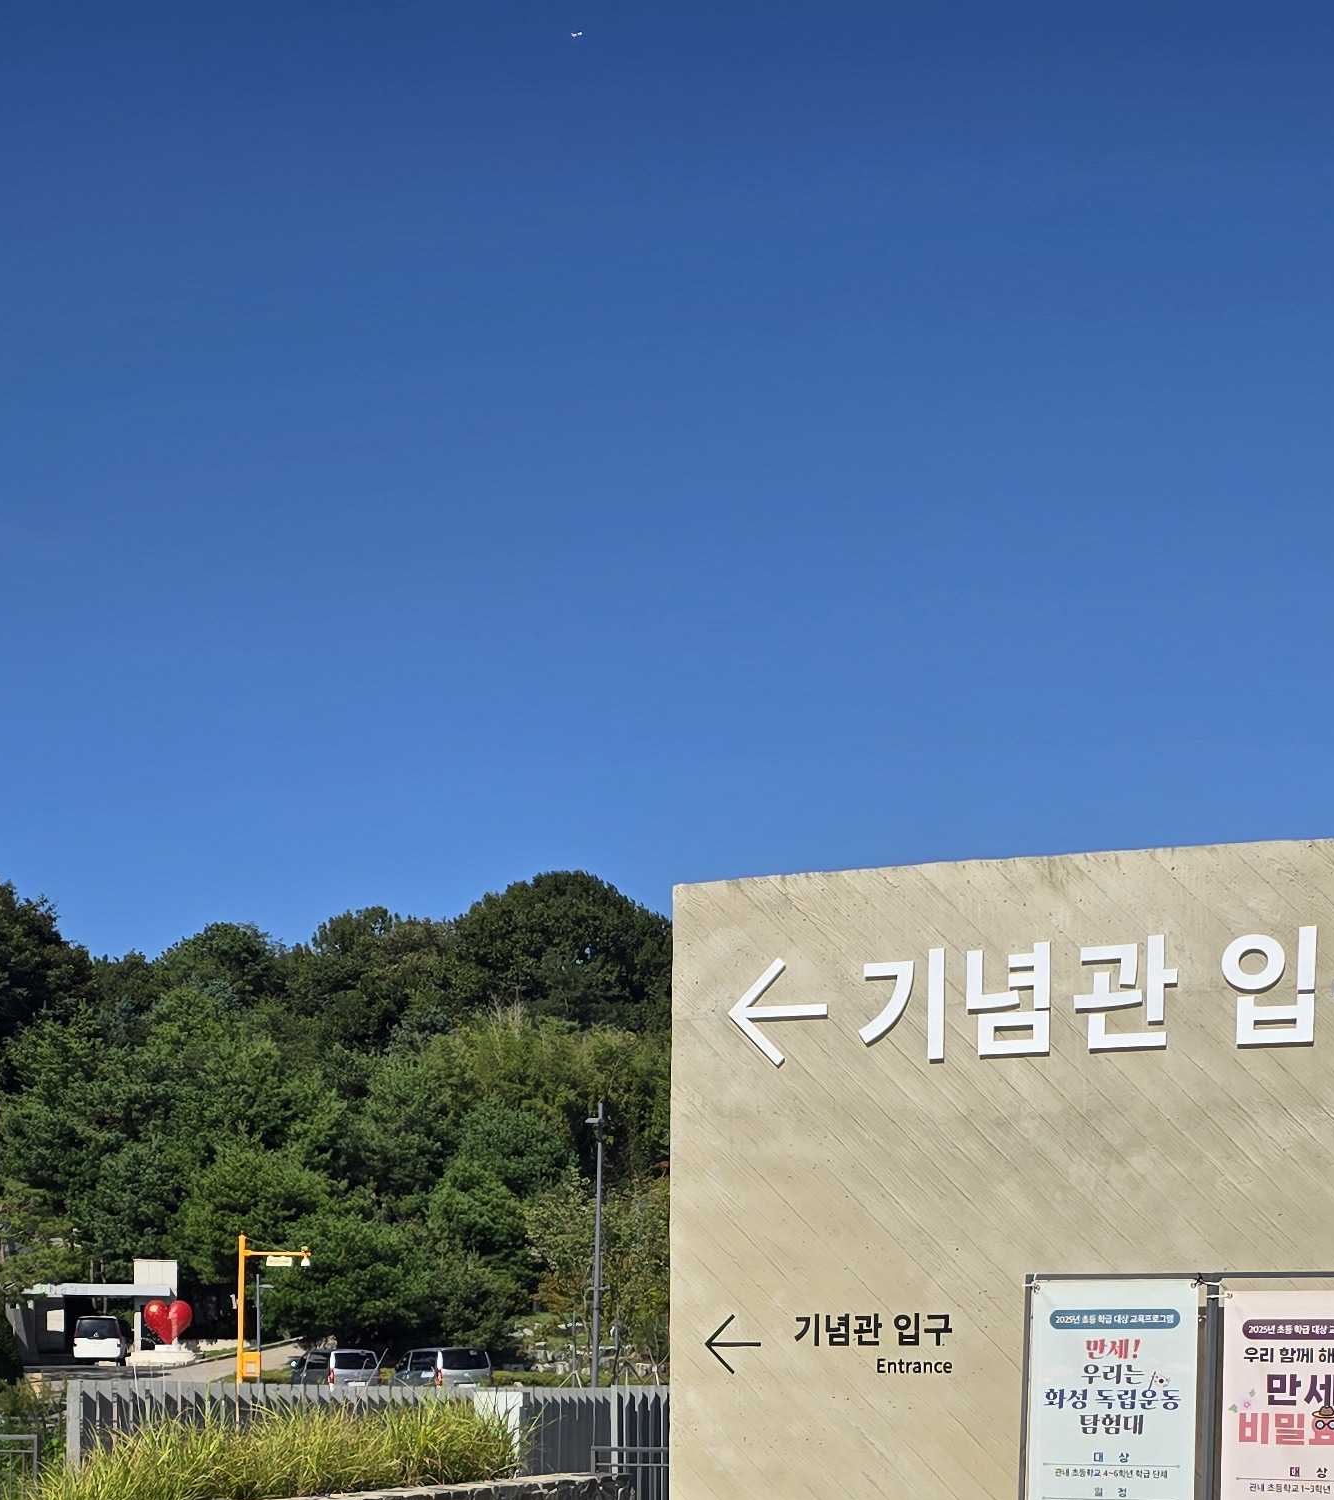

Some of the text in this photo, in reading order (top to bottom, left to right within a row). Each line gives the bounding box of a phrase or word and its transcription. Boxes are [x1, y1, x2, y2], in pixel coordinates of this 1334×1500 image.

[858, 934, 1178, 1063] 기념관
[1114, 1314, 1128, 1324] 대상
[1130, 1314, 1174, 1324] 교육프로그램
[794, 1313, 952, 1346] 기념관 입구
[1248, 1325, 1275, 1334] 2025년
[1277, 1325, 1292, 1334] 초등
[1294, 1325, 1309, 1334] 학급
[1311, 1325, 1327, 1334] 대상
[1085, 1339, 1140, 1359] 만세!
[1243, 1347, 1274, 1363] 우리
[1279, 1347, 1313, 1363] 함께
[876, 1358, 952, 1374] Entrance
[1081, 1364, 1145, 1384] 우리는
[1043, 1388, 1181, 1410] 화성 독립운동
[1080, 1414, 1143, 1435] 탐험대
[1071, 1468, 1101, 1477] 초등학교
[1267, 1484, 1299, 1493] 초등학교
